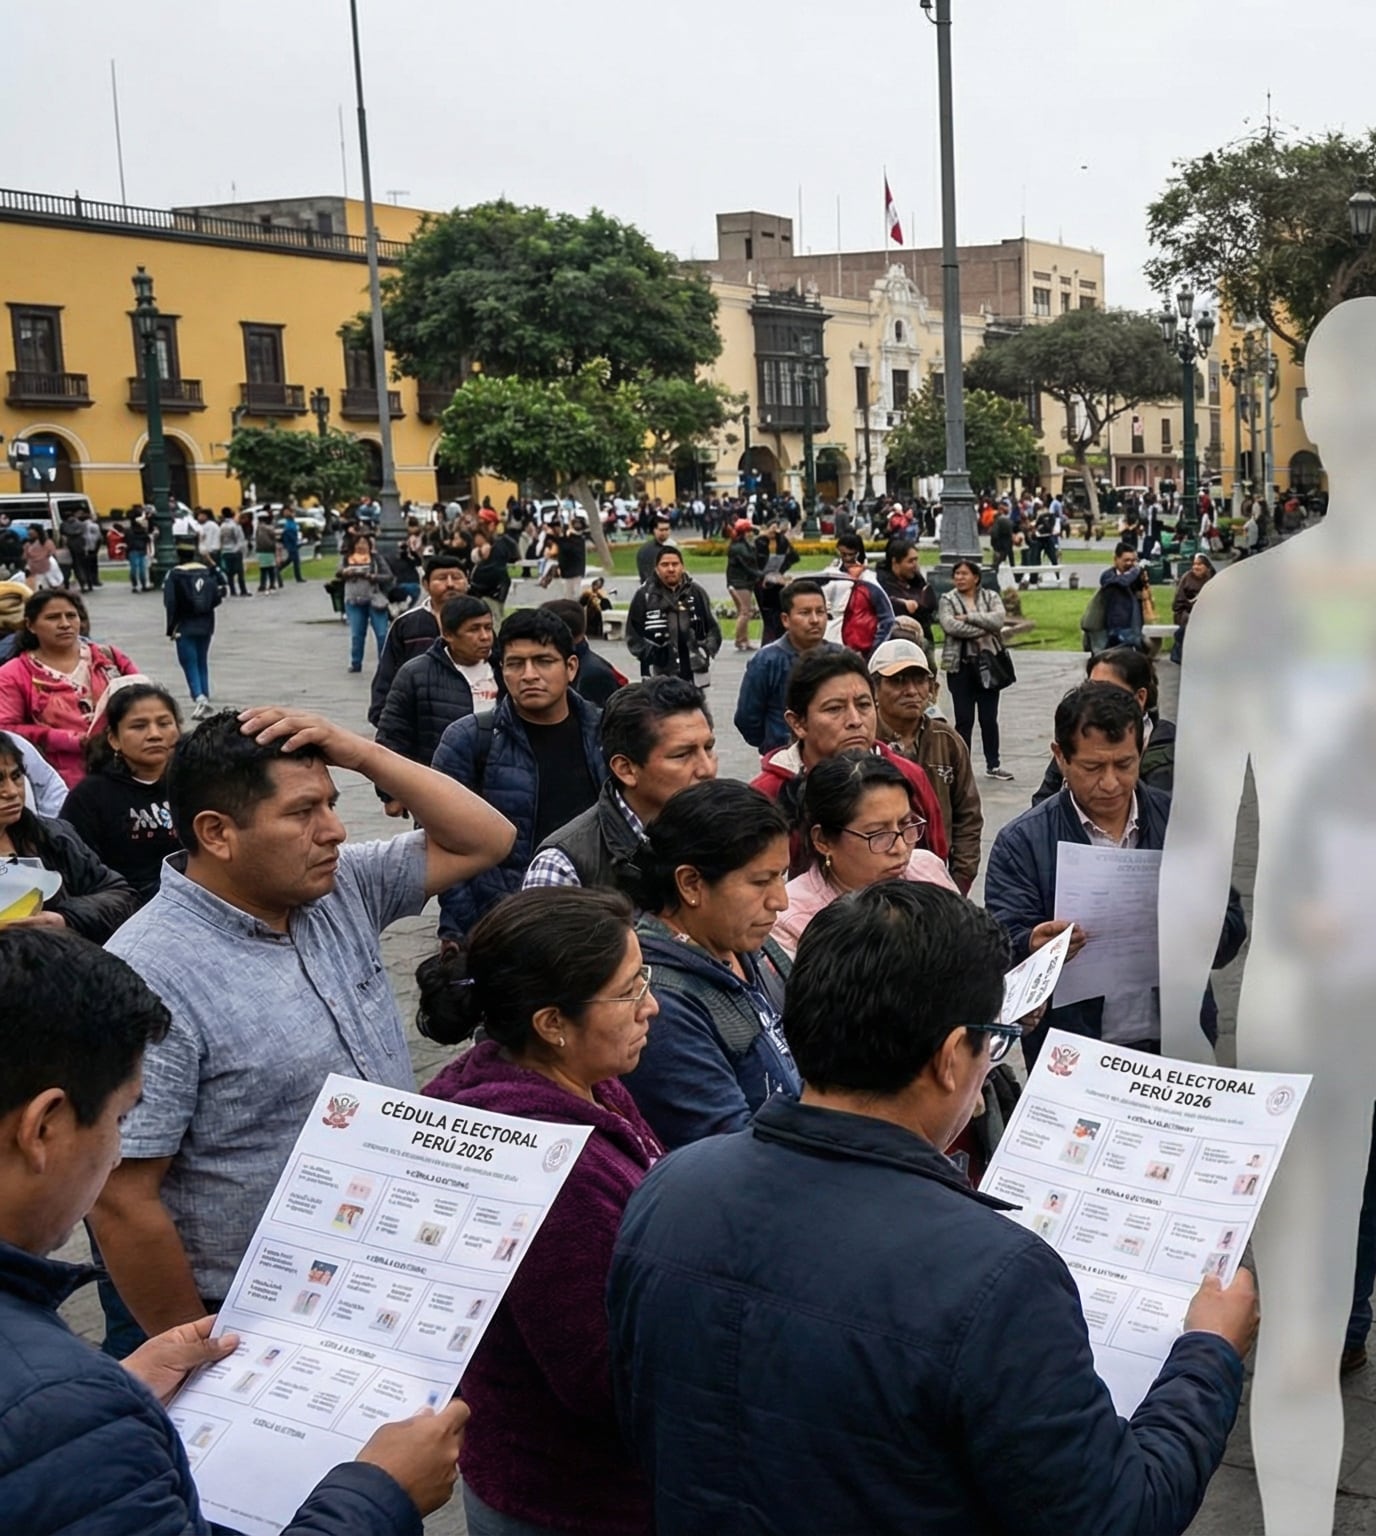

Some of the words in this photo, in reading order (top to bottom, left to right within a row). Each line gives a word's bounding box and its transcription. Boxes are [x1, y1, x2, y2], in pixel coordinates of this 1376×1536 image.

[1129, 1081, 1173, 1101] PERÚ
[1174, 1091, 1213, 1109] 2026
[1166, 1070, 1257, 1095] ELECTORAL
[381, 1101, 447, 1130] CÉDULA
[451, 1118, 539, 1149] ELECTORAL
[411, 1131, 457, 1153] PERÚ
[456, 1142, 495, 1162] 2026
